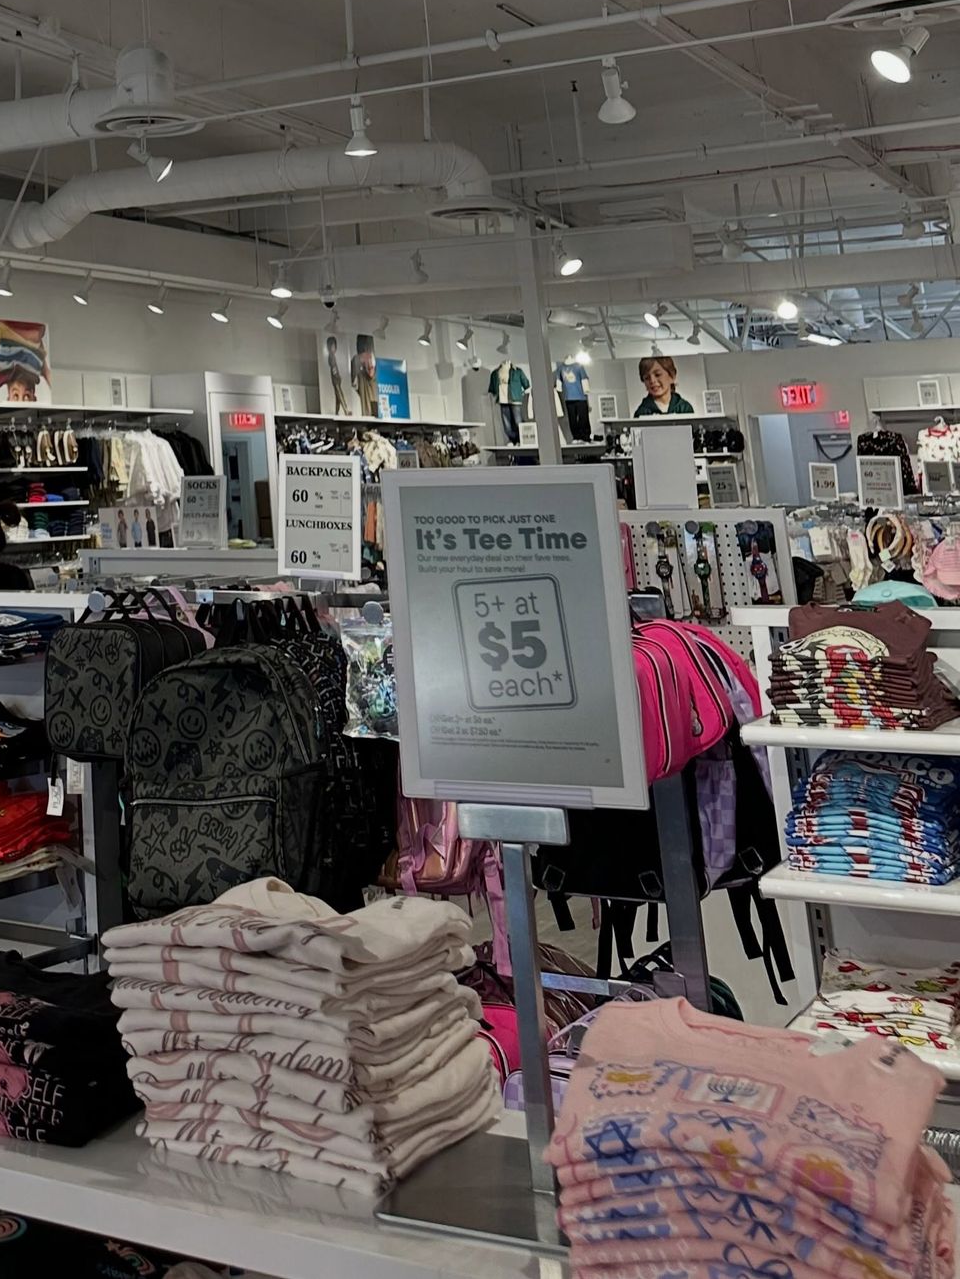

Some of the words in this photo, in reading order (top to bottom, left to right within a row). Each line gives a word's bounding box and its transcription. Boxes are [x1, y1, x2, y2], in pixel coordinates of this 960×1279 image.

[788, 385, 811, 405] EXIT
[286, 465, 352, 478] BACKPACKS
[187, 481, 217, 490] SOCKS
[292, 489, 309, 503] 60
[285, 519, 353, 531] LUNCHBOXES
[414, 515, 435, 525] TOO
[436, 515, 466, 525] GOOD
[467, 515, 481, 524] TO
[483, 515, 506, 524] PICK
[507, 514, 532, 524] JUST
[534, 514, 556, 523] ONE
[416, 528, 457, 551] It's
[462, 528, 512, 551] Tee
[518, 526, 588, 550] Time
[290, 549, 307, 564] 60
[450, 555, 484, 564] everyday
[474, 592, 505, 618] 5+
[515, 591, 540, 615] at
[478, 619, 547, 671] $5
[197, 811, 238, 850] BRUH
